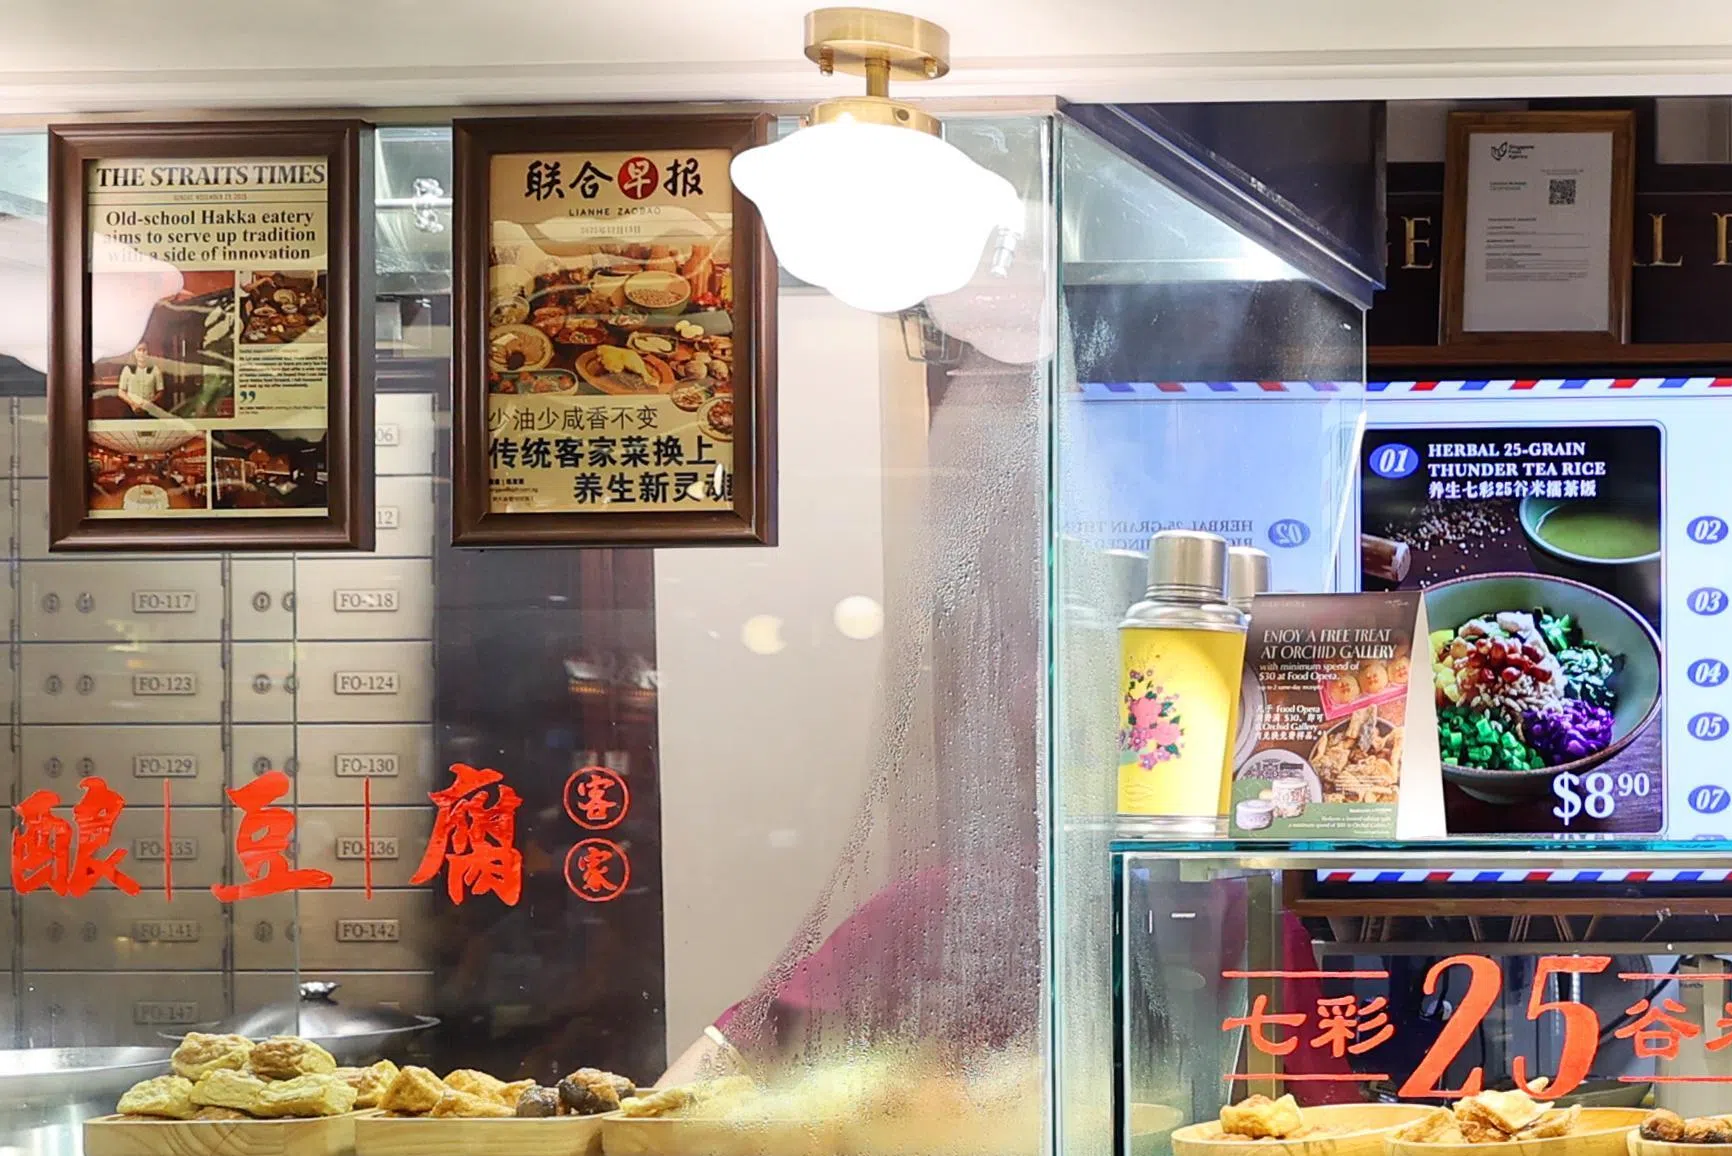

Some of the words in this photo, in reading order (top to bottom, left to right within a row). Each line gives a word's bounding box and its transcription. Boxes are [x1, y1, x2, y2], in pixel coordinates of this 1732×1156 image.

[97, 167, 145, 187] THE
[150, 165, 248, 187] STRAITS
[253, 164, 325, 185] TIMES
[525, 156, 704, 201] 联合早报
[106, 210, 195, 226] Old-school
[201, 210, 256, 225] Hakka
[262, 211, 314, 227] eatery
[569, 208, 610, 217] LIANHE
[147, 231, 162, 244] to
[168, 232, 210, 244] serve
[216, 231, 237, 246] up
[242, 228, 315, 243] tradition
[164, 247, 196, 262] side
[201, 246, 219, 261] of
[222, 246, 310, 262] innovation
[488, 405, 659, 432] 少油少咸香不变
[488, 435, 717, 469] 传统客家菜换上
[1428, 443, 1500, 458] HERBAL
[1504, 442, 1586, 457] 25-GRAIN
[1379, 448, 1408, 474] 01
[1428, 463, 1519, 477] THUNDER
[1523, 462, 1557, 476] TEA
[1561, 462, 1606, 476] RICE
[1694, 519, 1720, 541] 02
[139, 594, 192, 609] FO-117
[1694, 591, 1721, 612] 03
[1263, 629, 1303, 644] ENJOY
[1307, 629, 1316, 642] A
[1320, 629, 1351, 642] FREE
[1354, 628, 1392, 642] TREAT
[1260, 645, 1280, 659] AT
[1280, 645, 1336, 659] ORCHID
[1339, 644, 1397, 659] GALLERY
[1259, 662, 1278, 671] with
[1280, 662, 1321, 671] minimum
[1323, 662, 1349, 672] spend
[1350, 661, 1360, 670] of
[1695, 663, 1722, 684] 04
[139, 676, 192, 691] FO-123
[340, 675, 394, 690] FO-124
[1287, 671, 1309, 680] Food
[1310, 671, 1340, 683] Opera.
[1695, 716, 1722, 737] 05
[139, 757, 193, 772] FO-129
[341, 757, 394, 772] FO-130
[1695, 788, 1722, 810] 07
[140, 922, 193, 937] FO-141
[342, 922, 396, 937] FO-142
